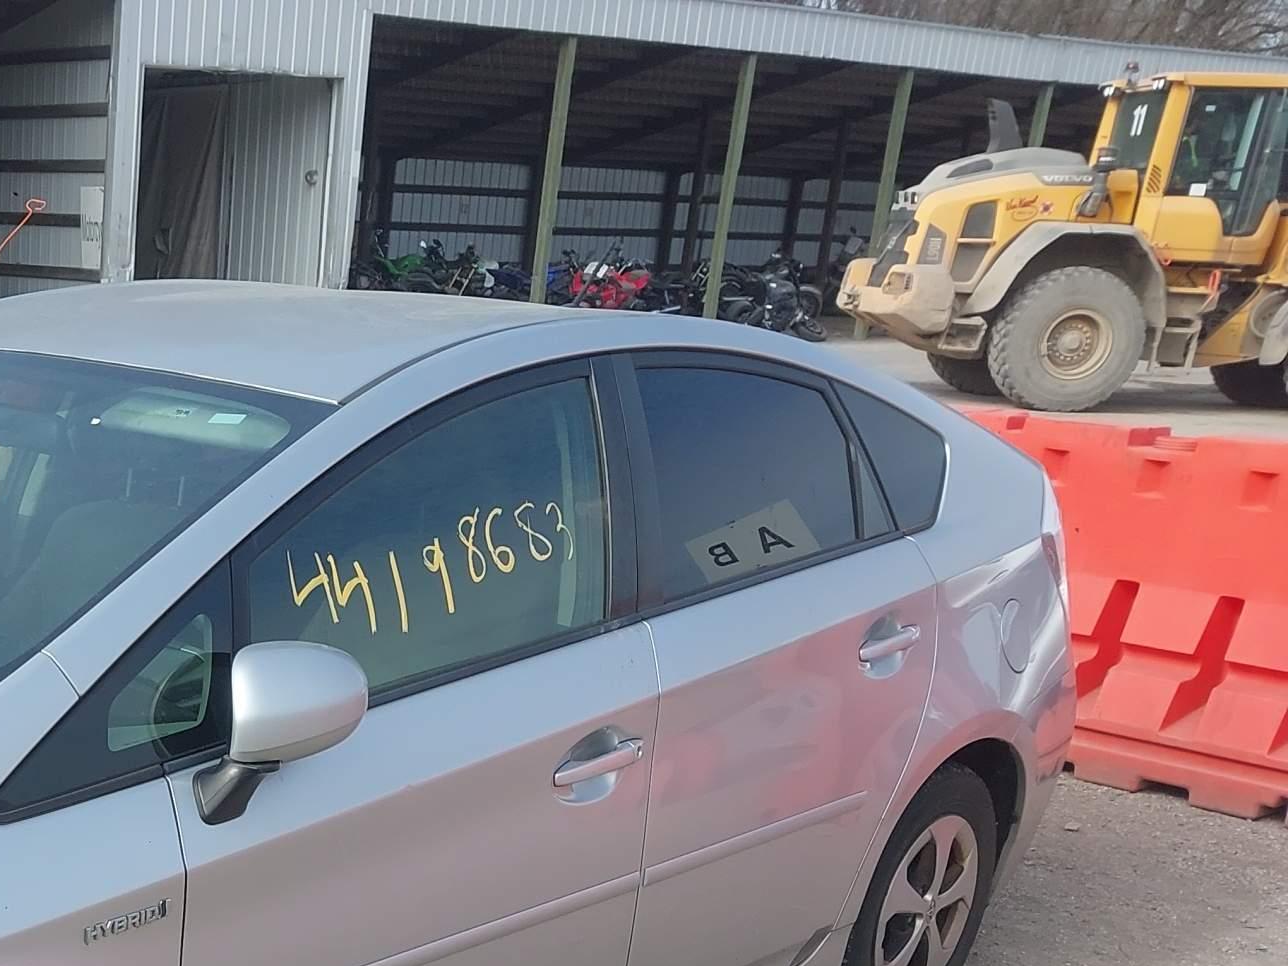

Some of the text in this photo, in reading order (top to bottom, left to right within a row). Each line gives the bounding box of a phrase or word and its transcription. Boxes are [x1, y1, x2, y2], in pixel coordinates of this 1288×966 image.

[1130, 103, 1149, 137] 11
[1041, 174, 1094, 183] VOLVO
[287, 499, 574, 634] 44198683
[83, 901, 167, 946] HYBRID
